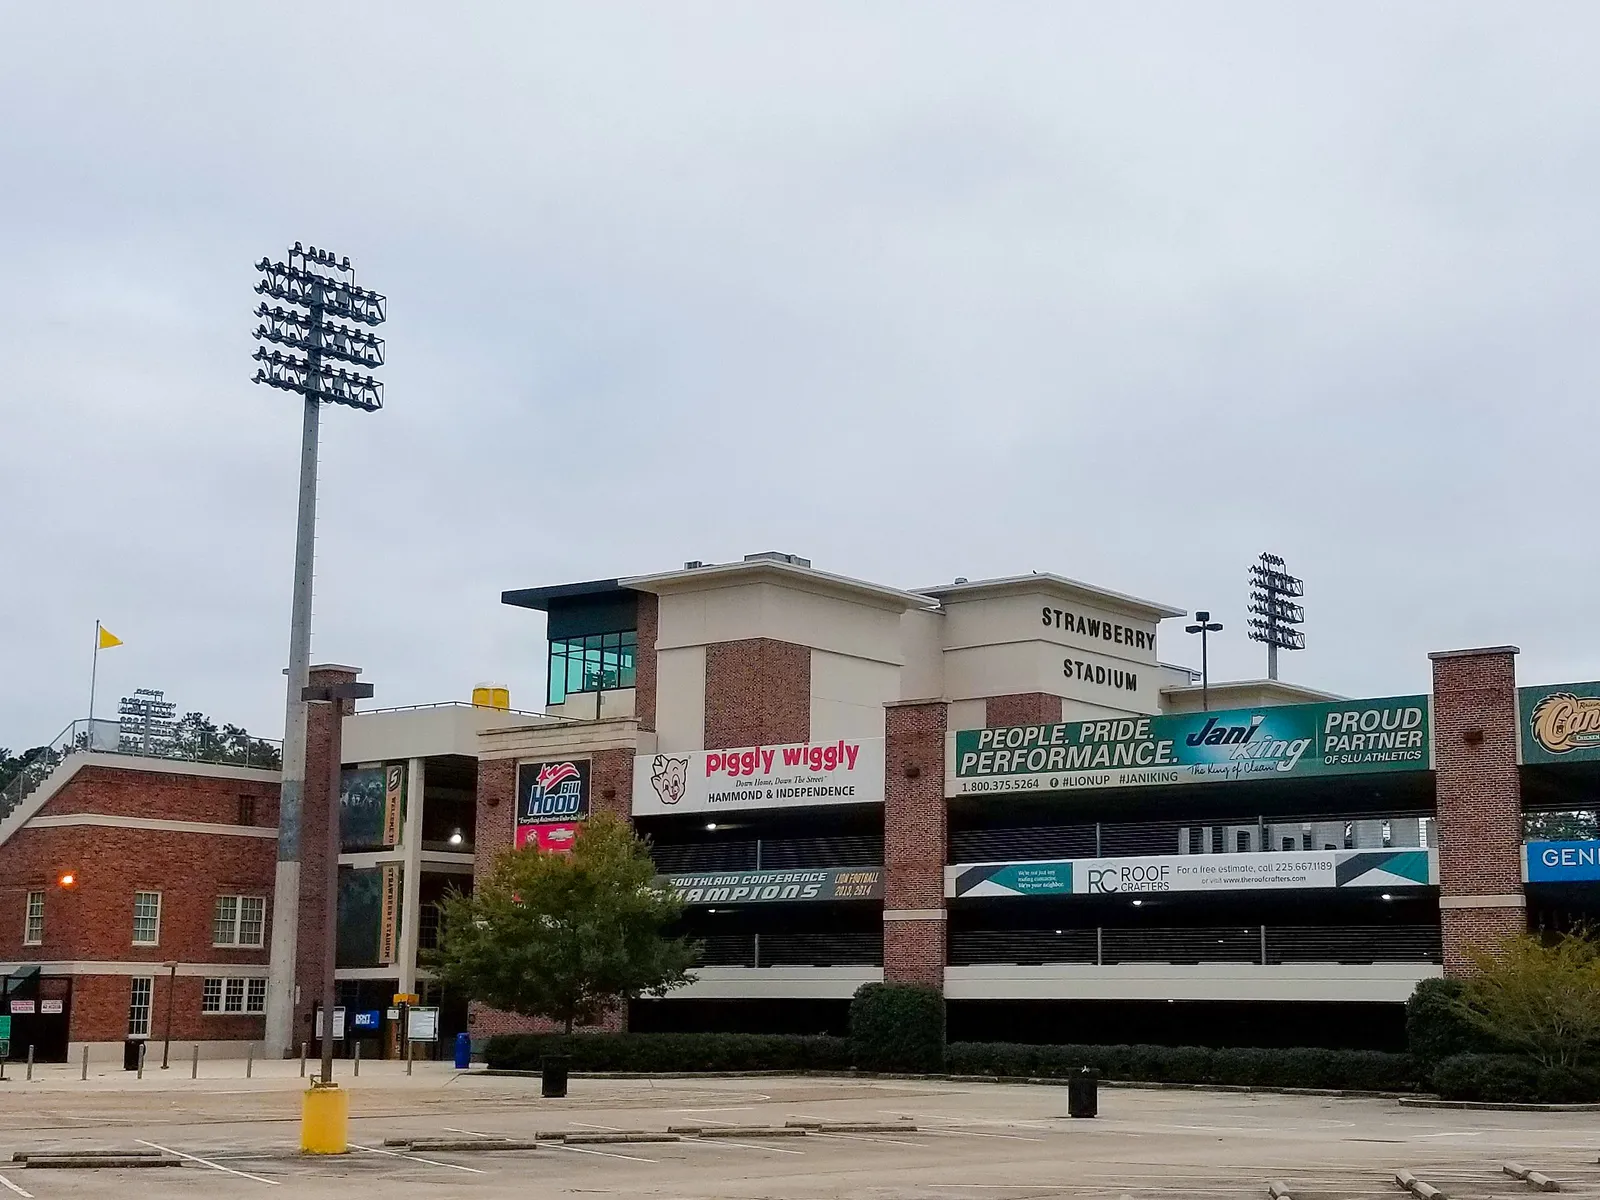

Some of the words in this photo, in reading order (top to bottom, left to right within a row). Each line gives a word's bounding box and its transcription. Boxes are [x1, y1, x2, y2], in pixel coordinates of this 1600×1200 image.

[1042, 607, 1155, 650] STRAWBERRY
[1063, 658, 1137, 692] STADIUM
[1325, 708, 1422, 734] PROUD
[978, 724, 1070, 749] PEOPLE.
[1079, 719, 1154, 743] PRIDE.
[1186, 715, 1267, 747] Jani
[1324, 730, 1423, 752] PARTNER
[705, 747, 776, 777] piggly
[783, 740, 860, 772] wiggly
[960, 740, 1179, 775] PERFORMANCE.
[1324, 755, 1339, 765] OF
[1340, 753, 1362, 764] SLU
[1363, 750, 1422, 763] ATHLETICS
[1187, 762, 1205, 775] The
[1207, 762, 1230, 779] King
[1232, 762, 1242, 779] of
[560, 780, 581, 794] Bill
[961, 778, 1040, 792] 1.800.375.5264
[1062, 775, 1110, 787] #LIONUP
[1119, 772, 1178, 785] #JANIKING
[708, 789, 763, 803] HAMMOND
[766, 788, 774, 799] &
[776, 786, 855, 799] INDEPENDENCE
[1120, 866, 1170, 882] ROOF
[1176, 865, 1191, 874] For
[1200, 865, 1216, 874] free
[1217, 864, 1256, 874] estimate,
[1257, 863, 1274, 872] call
[1275, 861, 1333, 872] 225.667.1189
[667, 876, 740, 887] SOUTHLAND
[741, 872, 828, 885] CONFERENCE
[1087, 869, 1118, 894] RC
[1120, 881, 1170, 892] CRAFTERS
[1201, 877, 1209, 885] or
[1223, 874, 1307, 884] www.theroofcrafters.com
